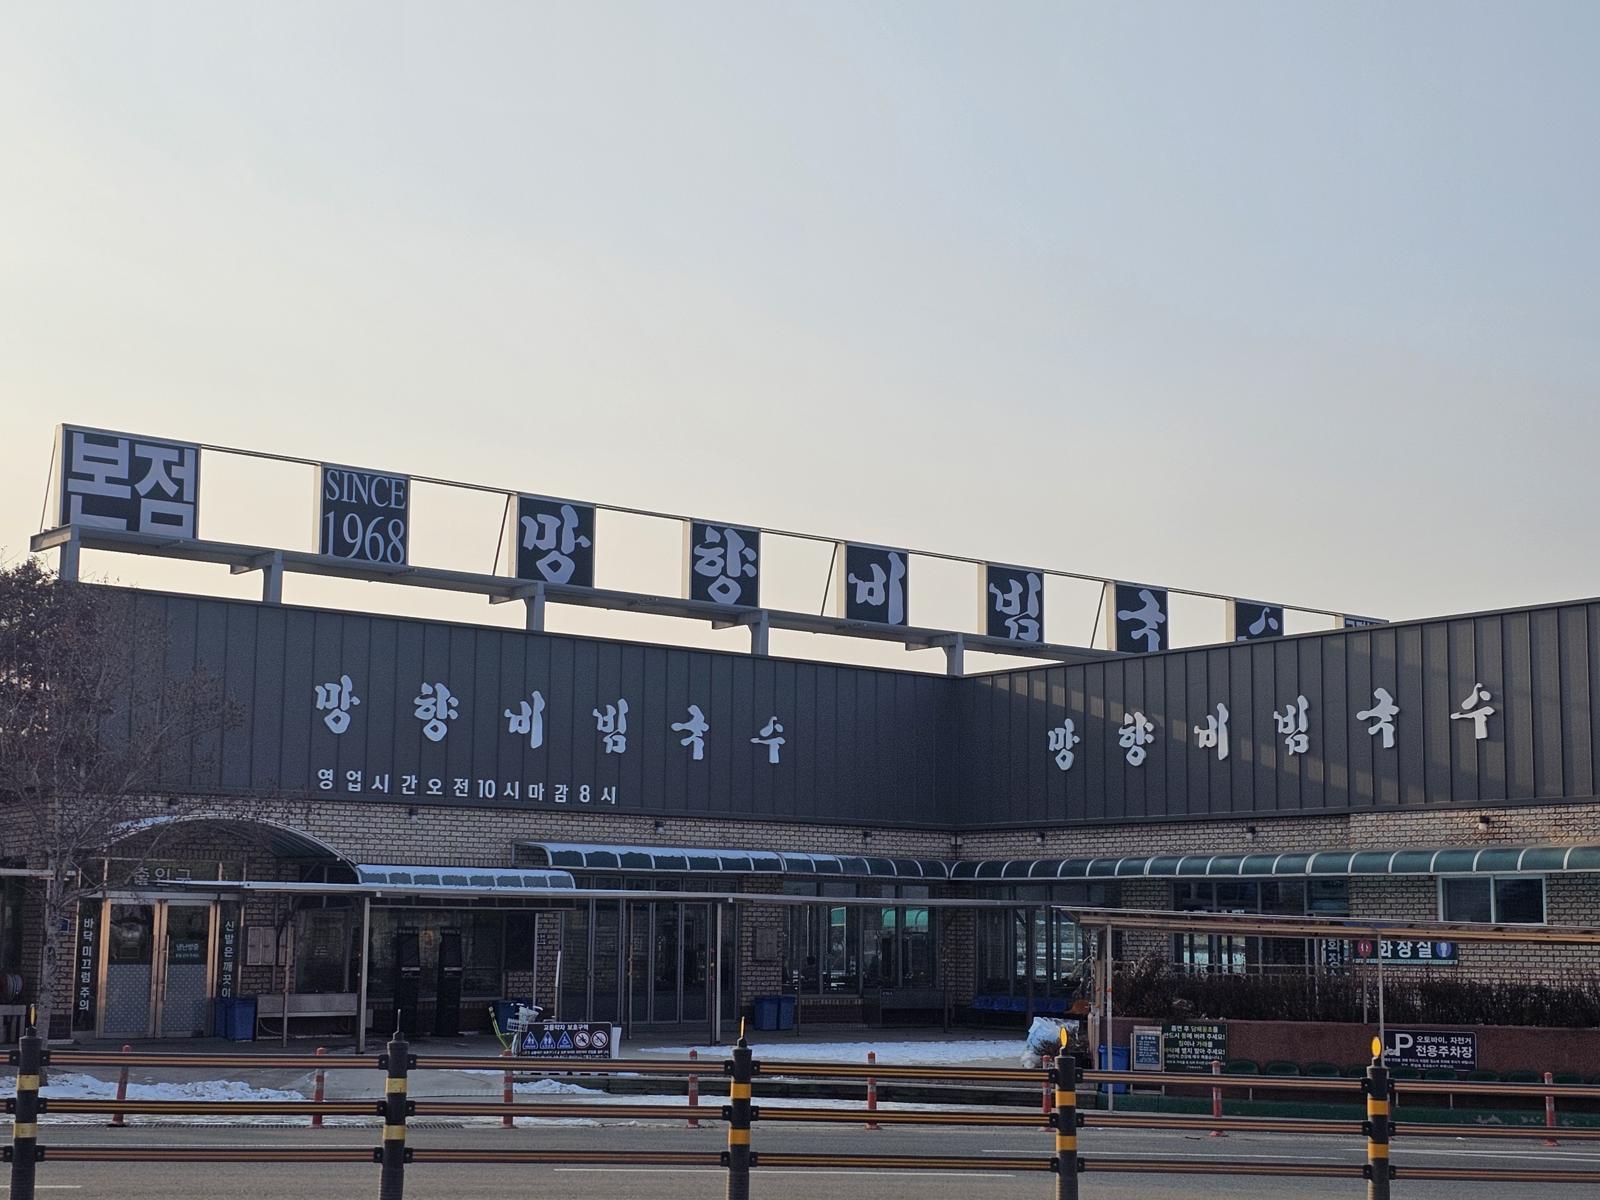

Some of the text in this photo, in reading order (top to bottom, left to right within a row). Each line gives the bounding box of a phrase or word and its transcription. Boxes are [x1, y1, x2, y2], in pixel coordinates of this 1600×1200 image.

[67, 431, 196, 538] 본점
[325, 469, 405, 511] SINCE
[323, 511, 405, 565] 1968
[1380, 940, 1432, 958] 화장실
[1415, 1045, 1473, 1059] 전용주차장
[1450, 1036, 1472, 1045] 자전거
